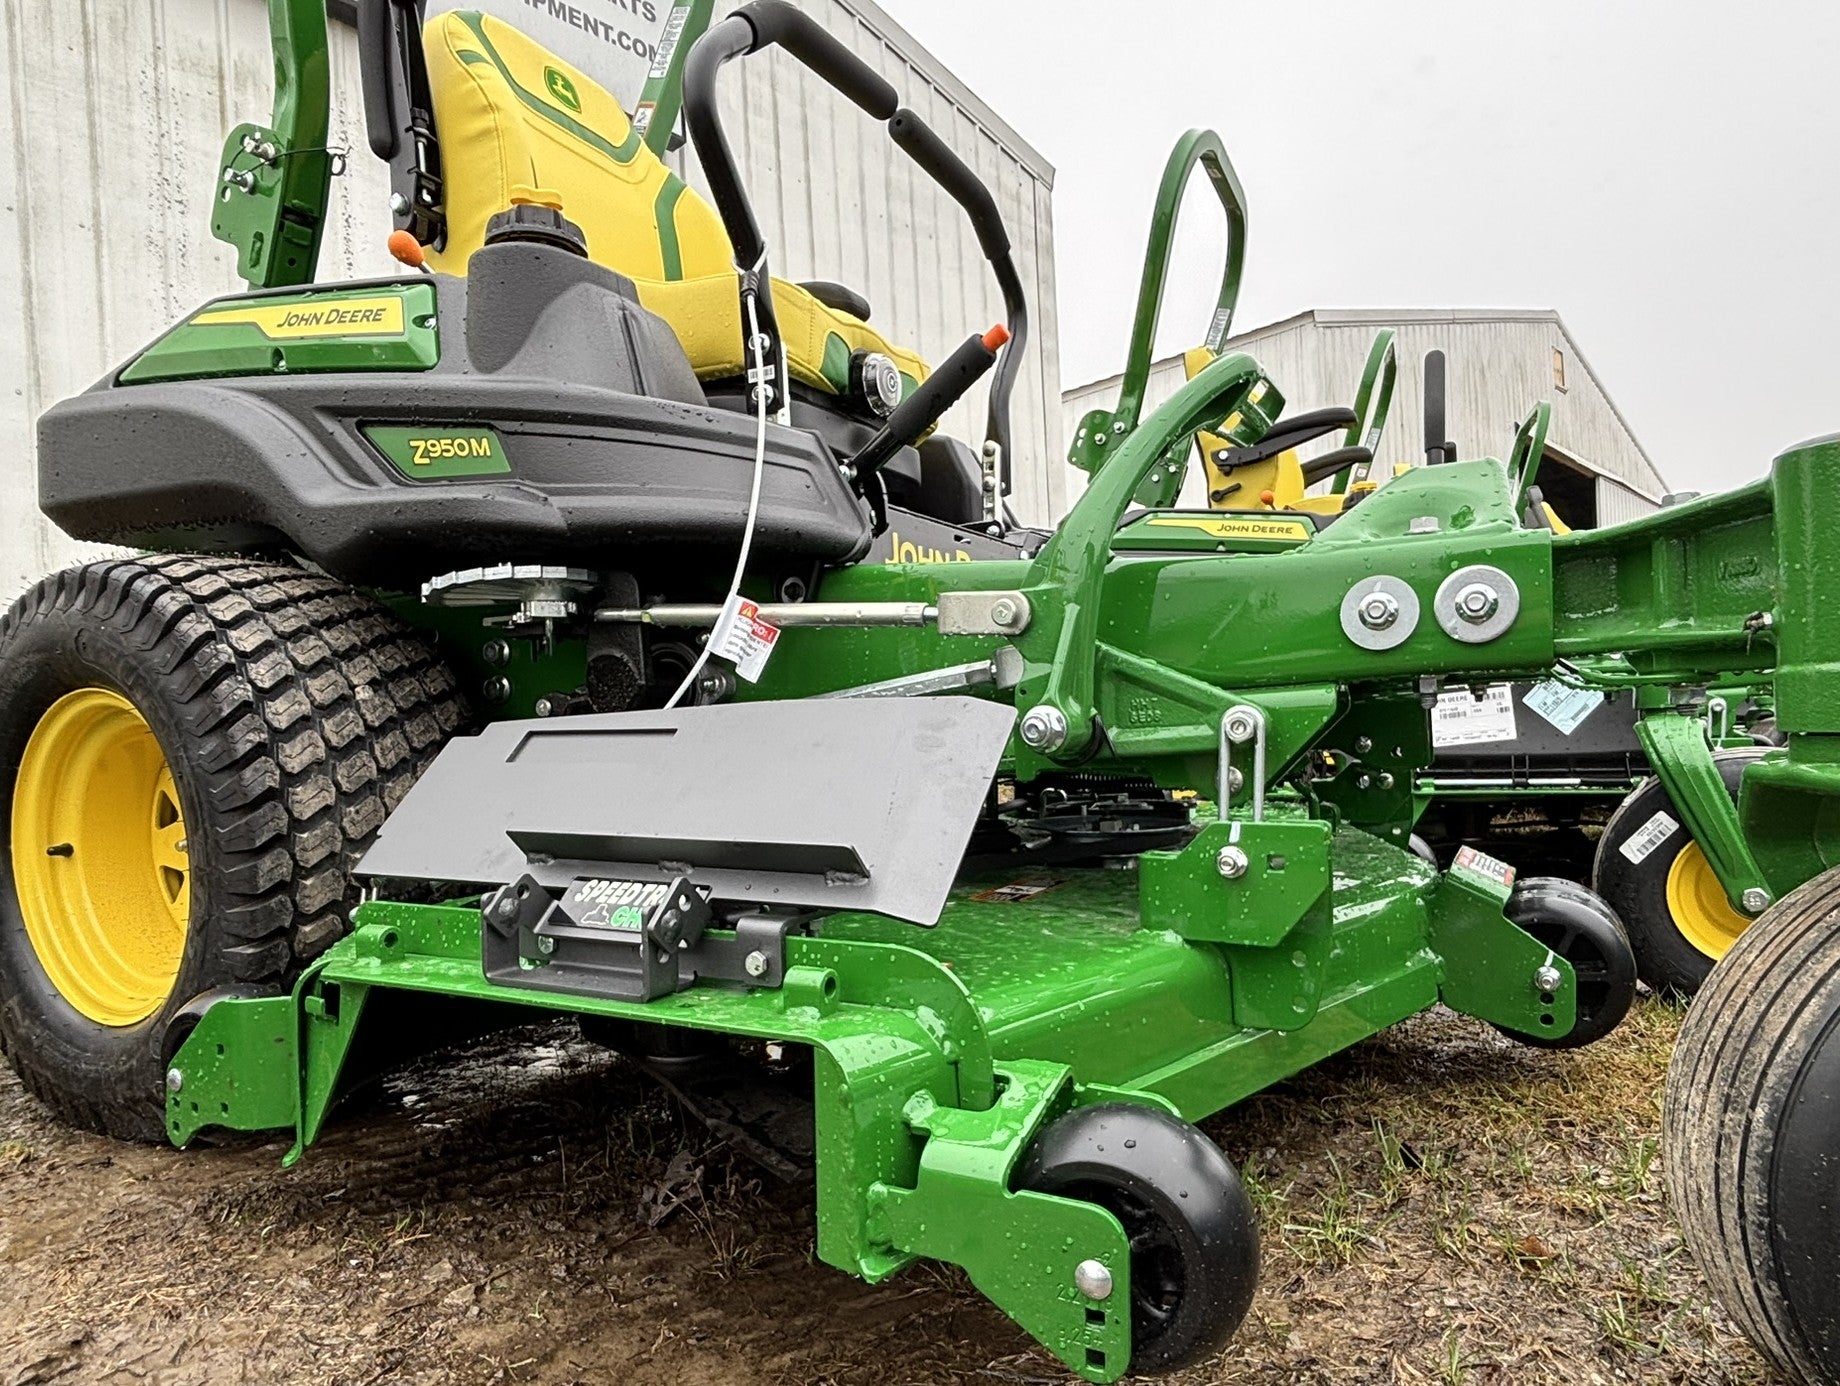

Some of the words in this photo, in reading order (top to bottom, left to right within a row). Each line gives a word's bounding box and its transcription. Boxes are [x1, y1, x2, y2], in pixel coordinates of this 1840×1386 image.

[276, 311, 324, 328] JOHN
[324, 308, 387, 325] DEERE
[408, 437, 492, 465] Z950M
[1216, 523, 1249, 533] JOHN
[1251, 524, 1294, 535] DEERE
[884, 531, 950, 565] JOHN
[574, 879, 669, 907] SPEEDTR
